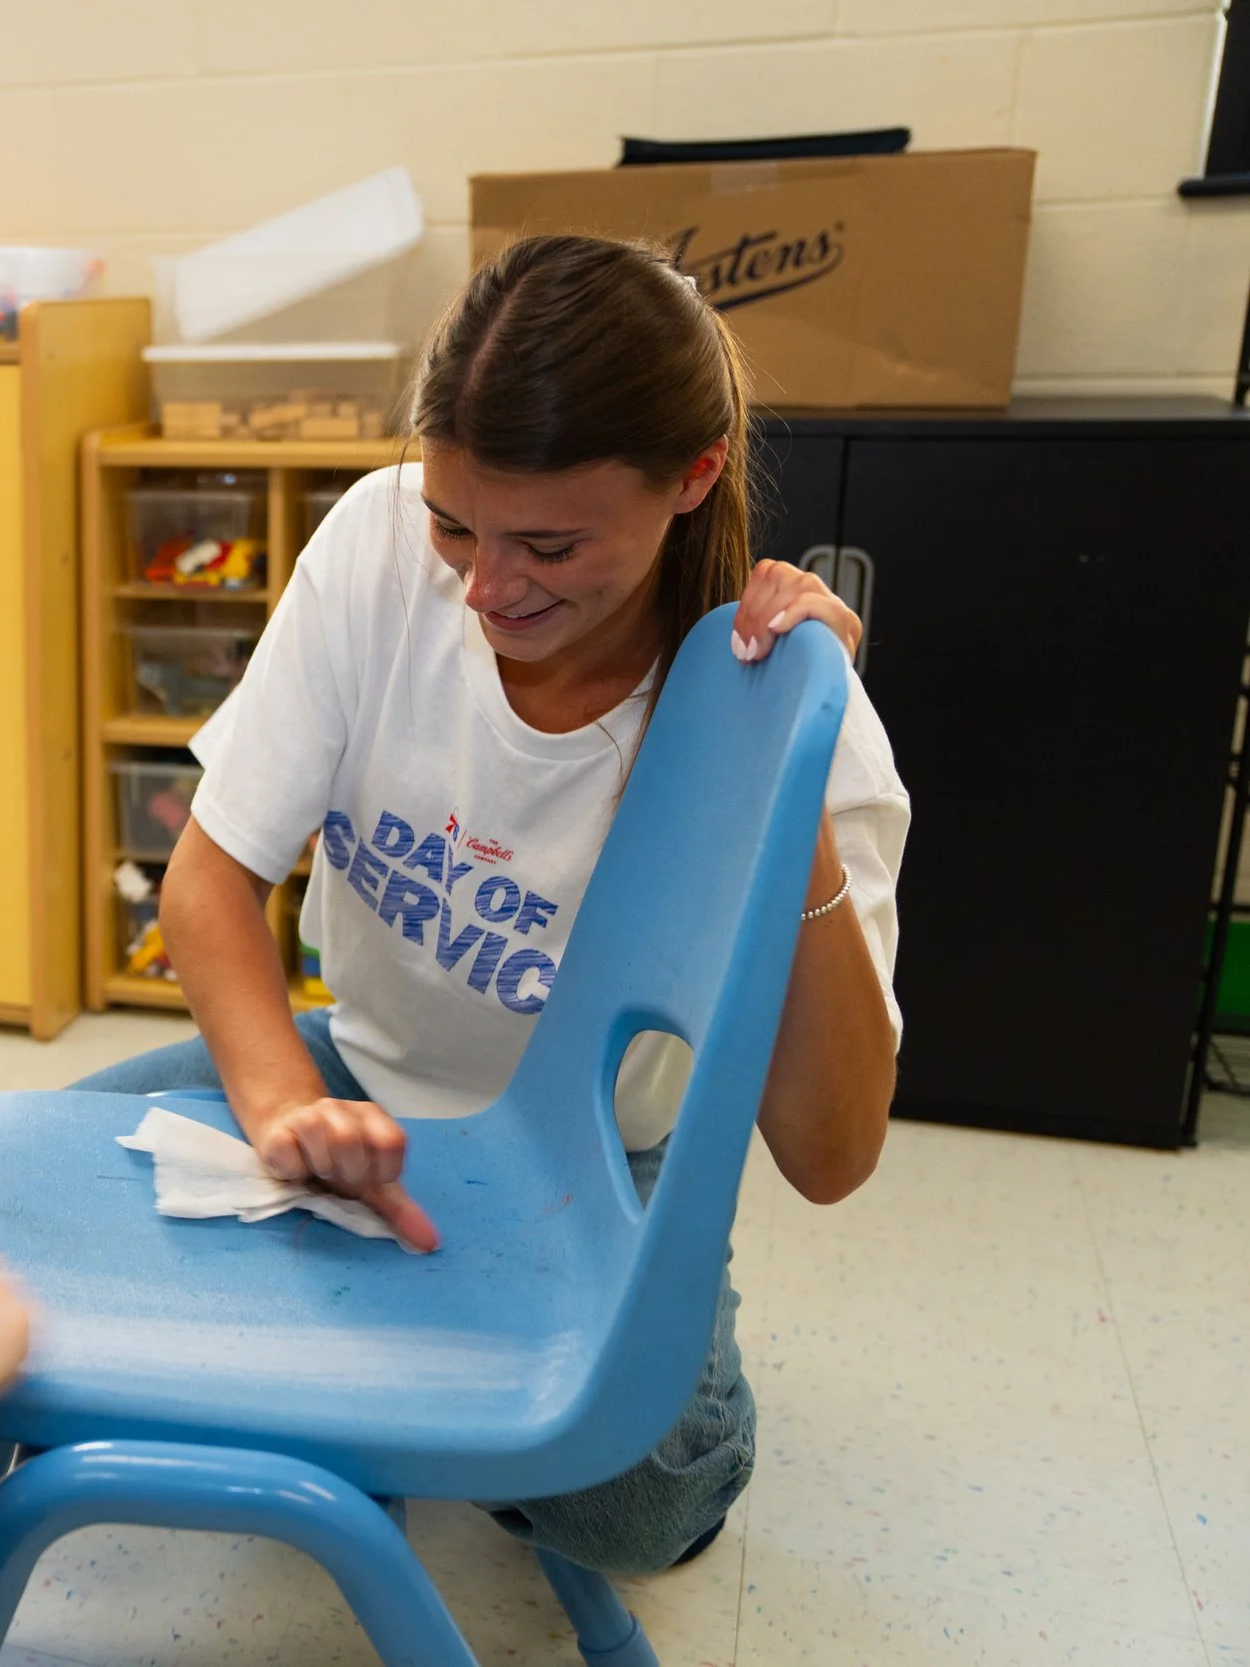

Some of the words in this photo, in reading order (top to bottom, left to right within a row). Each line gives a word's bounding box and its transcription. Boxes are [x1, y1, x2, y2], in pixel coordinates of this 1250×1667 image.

[671, 224, 832, 294] stens
[371, 810, 473, 895] DAY
[474, 875, 559, 935] OF
[466, 836, 514, 861] Campbell's
[322, 810, 557, 1015] SERVIC
